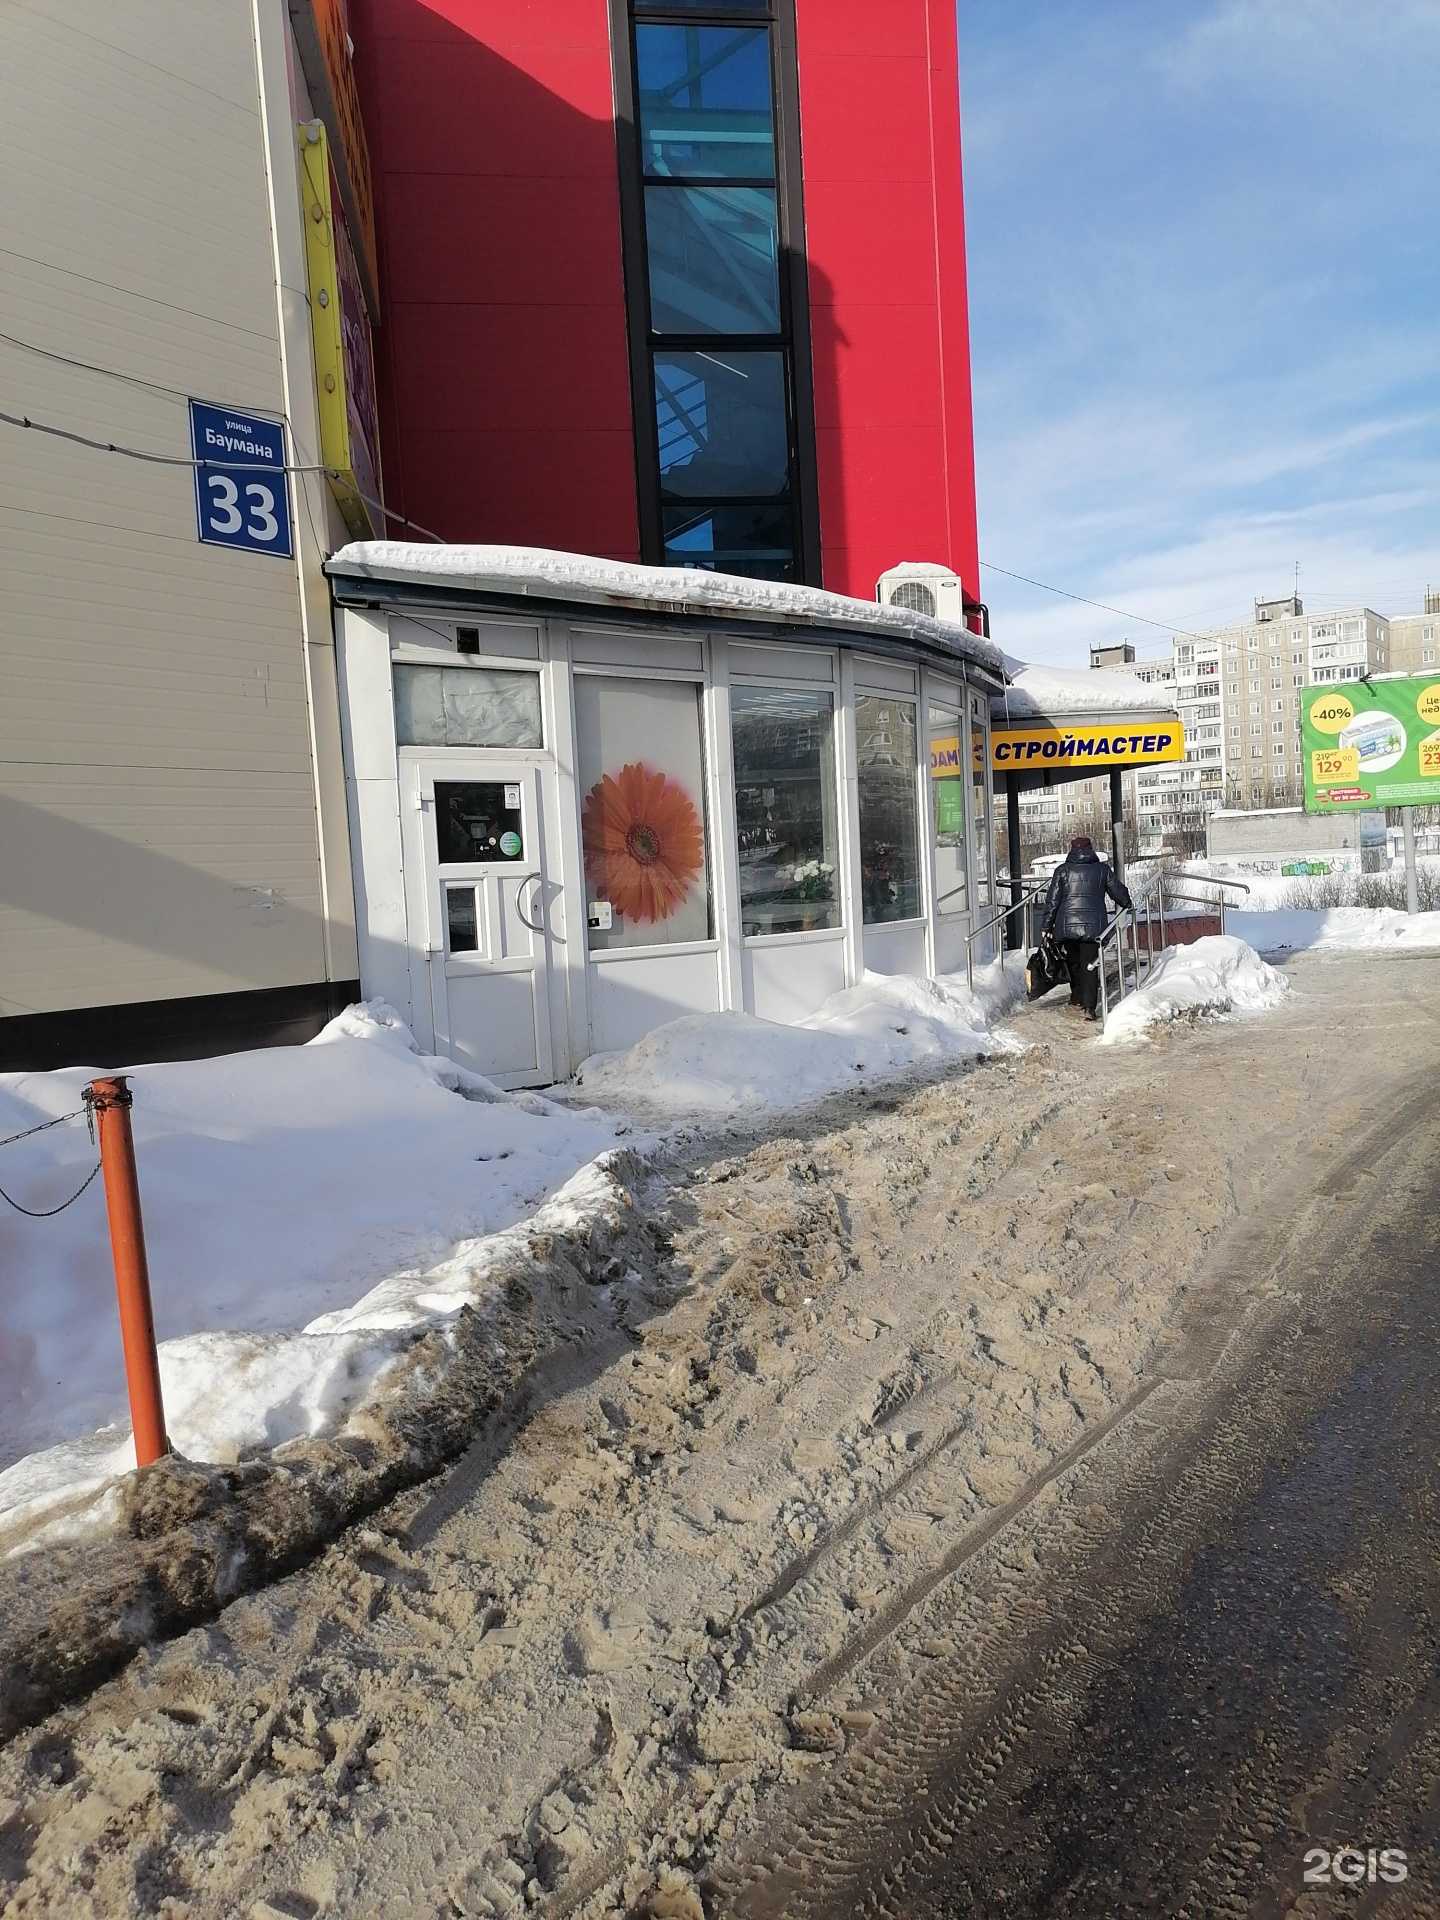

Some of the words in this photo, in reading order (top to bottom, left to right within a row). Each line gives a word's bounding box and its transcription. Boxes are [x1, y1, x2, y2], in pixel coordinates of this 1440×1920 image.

[225, 419, 252, 434] улица
[205, 428, 273, 459] Баумана
[208, 475, 279, 541] 33
[1313, 707, 1351, 719] -40%
[994, 734, 1172, 761] СТРОЙМАСТЕР
[1317, 760, 1342, 773] 129
